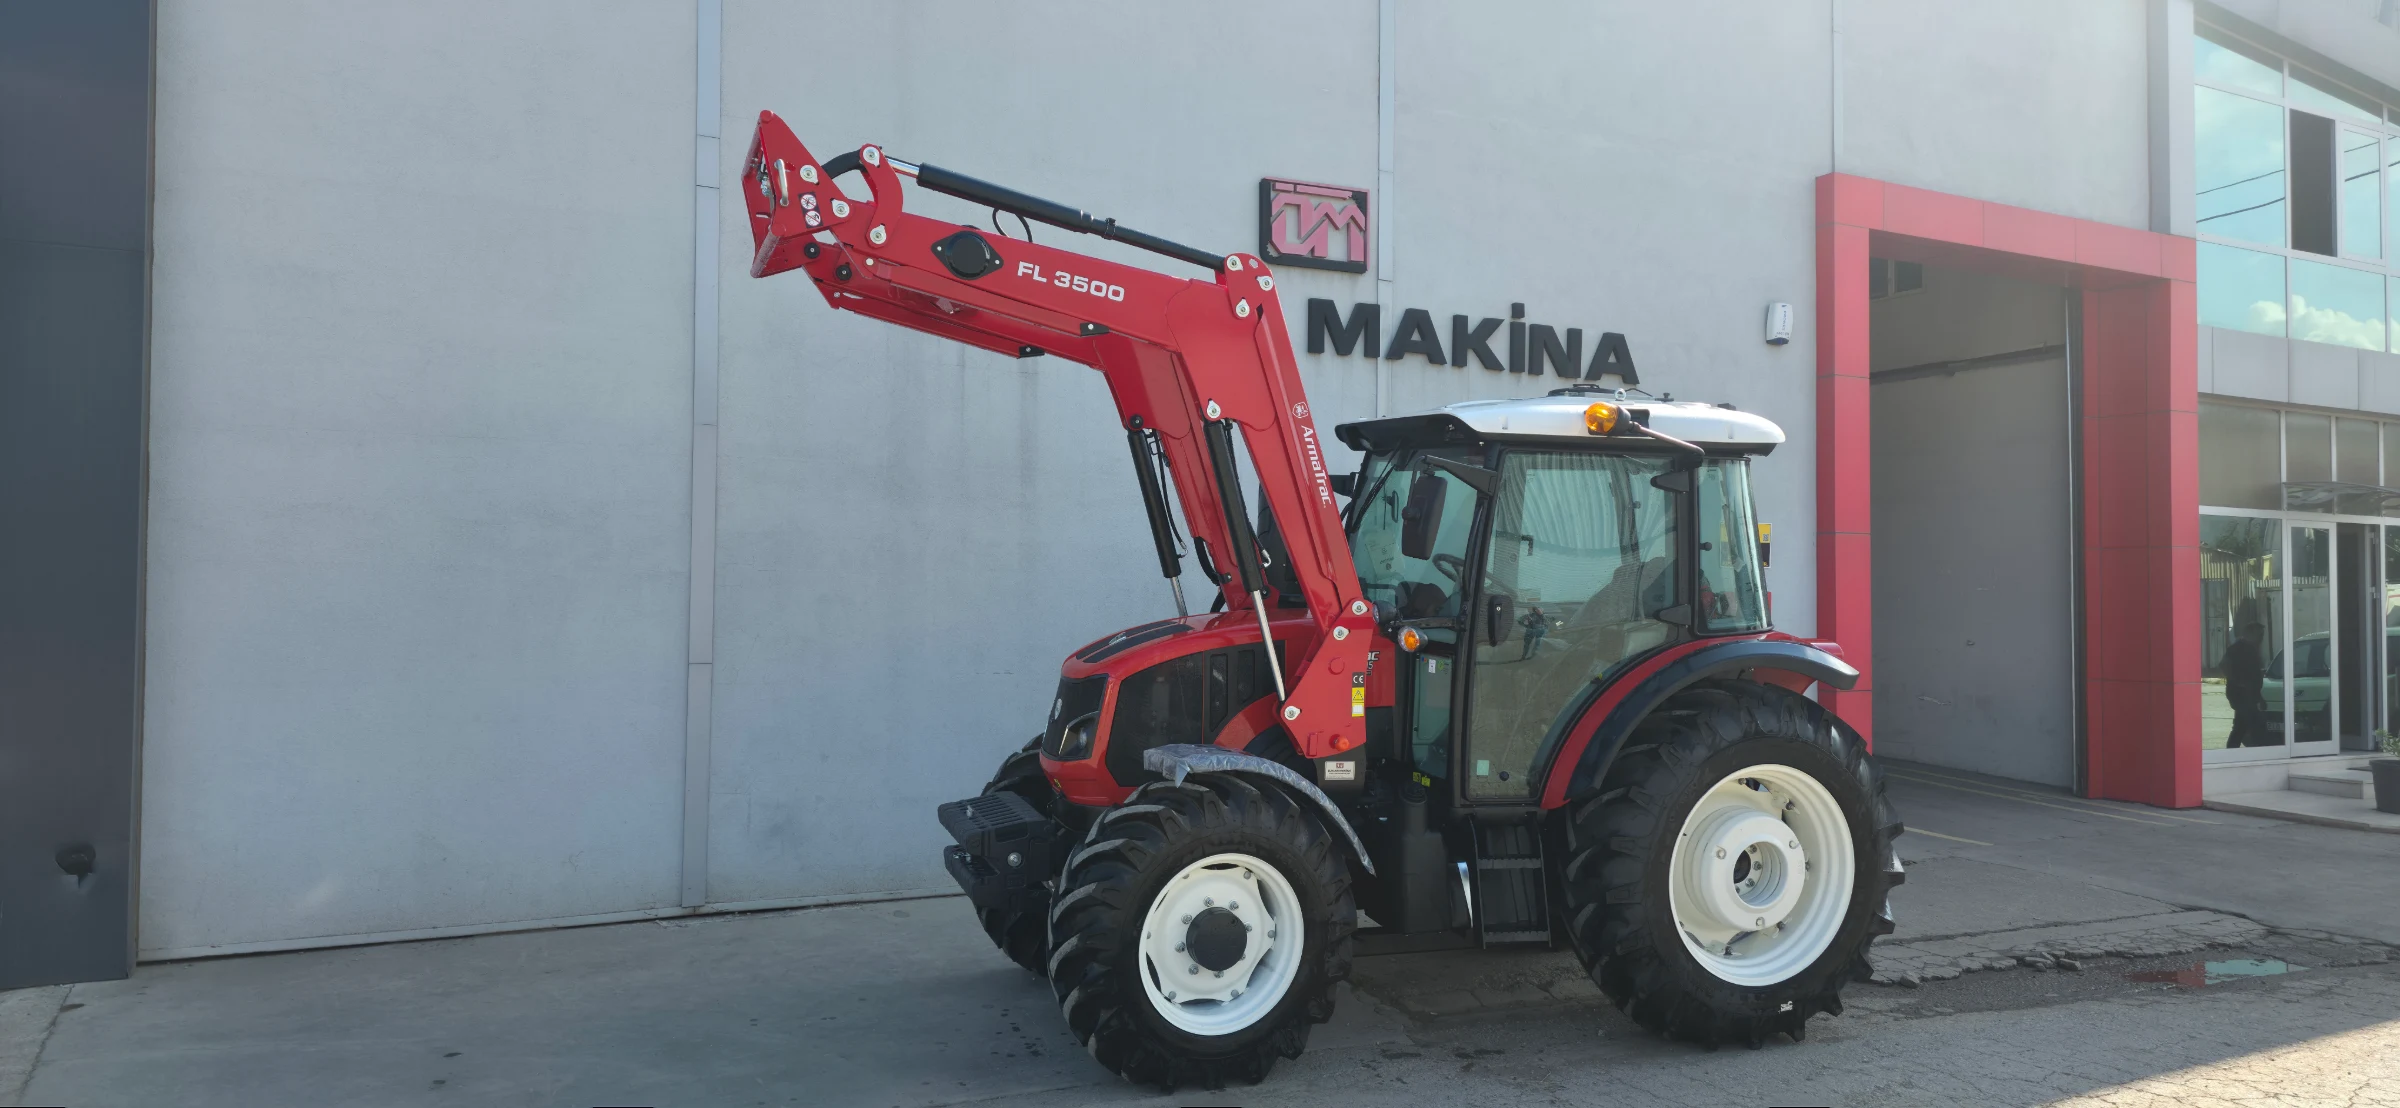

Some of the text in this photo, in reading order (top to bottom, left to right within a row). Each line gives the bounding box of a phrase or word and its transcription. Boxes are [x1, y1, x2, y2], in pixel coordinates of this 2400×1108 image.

[1017, 261, 1125, 302] FL 3500
[1307, 297, 1640, 385] MAKİNA
